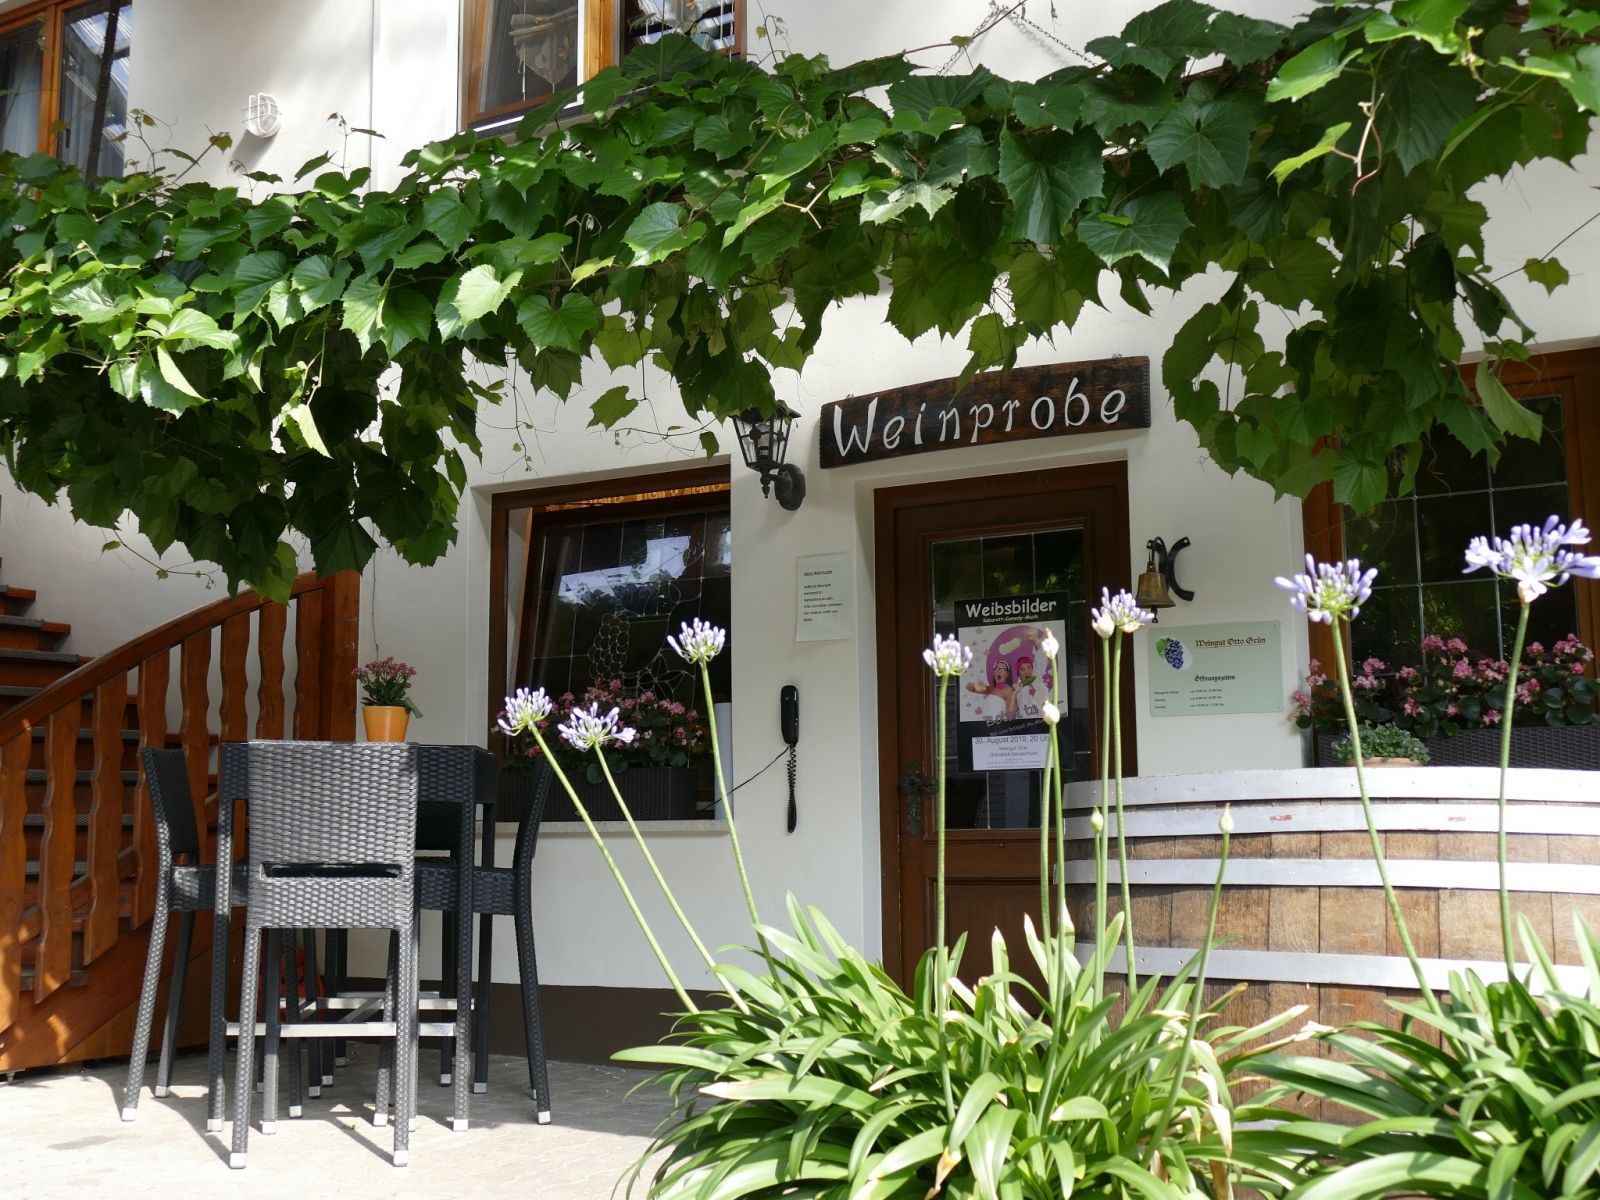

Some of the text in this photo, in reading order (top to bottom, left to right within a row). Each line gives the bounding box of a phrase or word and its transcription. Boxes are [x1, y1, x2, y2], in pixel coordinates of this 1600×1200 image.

[833, 377, 1125, 457] Weinprobe
[965, 598, 1057, 619] Weibsbilder
[1195, 636, 1266, 648] Weingut Otto Grün
[986, 736, 1009, 745] August
